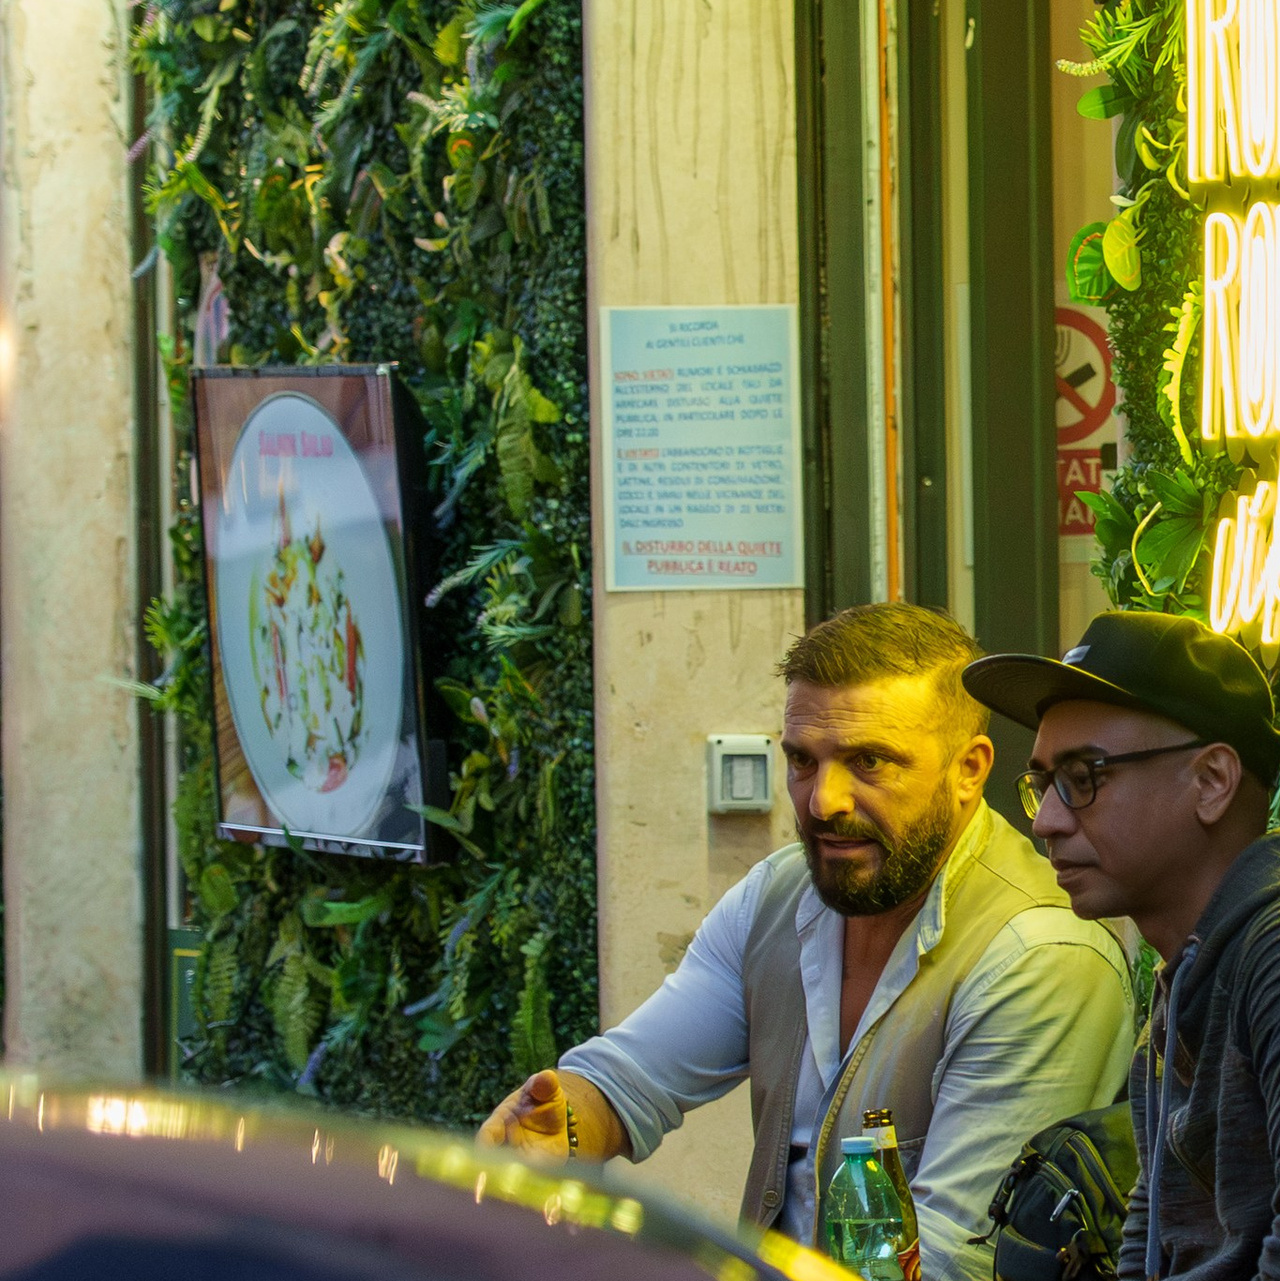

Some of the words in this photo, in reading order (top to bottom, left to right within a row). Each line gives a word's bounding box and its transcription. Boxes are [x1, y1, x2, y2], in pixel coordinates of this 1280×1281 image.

[635, 540, 695, 554] DISTURBO
[697, 540, 733, 554] DELLA
[737, 540, 783, 556] QUIETE
[717, 560, 758, 575] REATO
